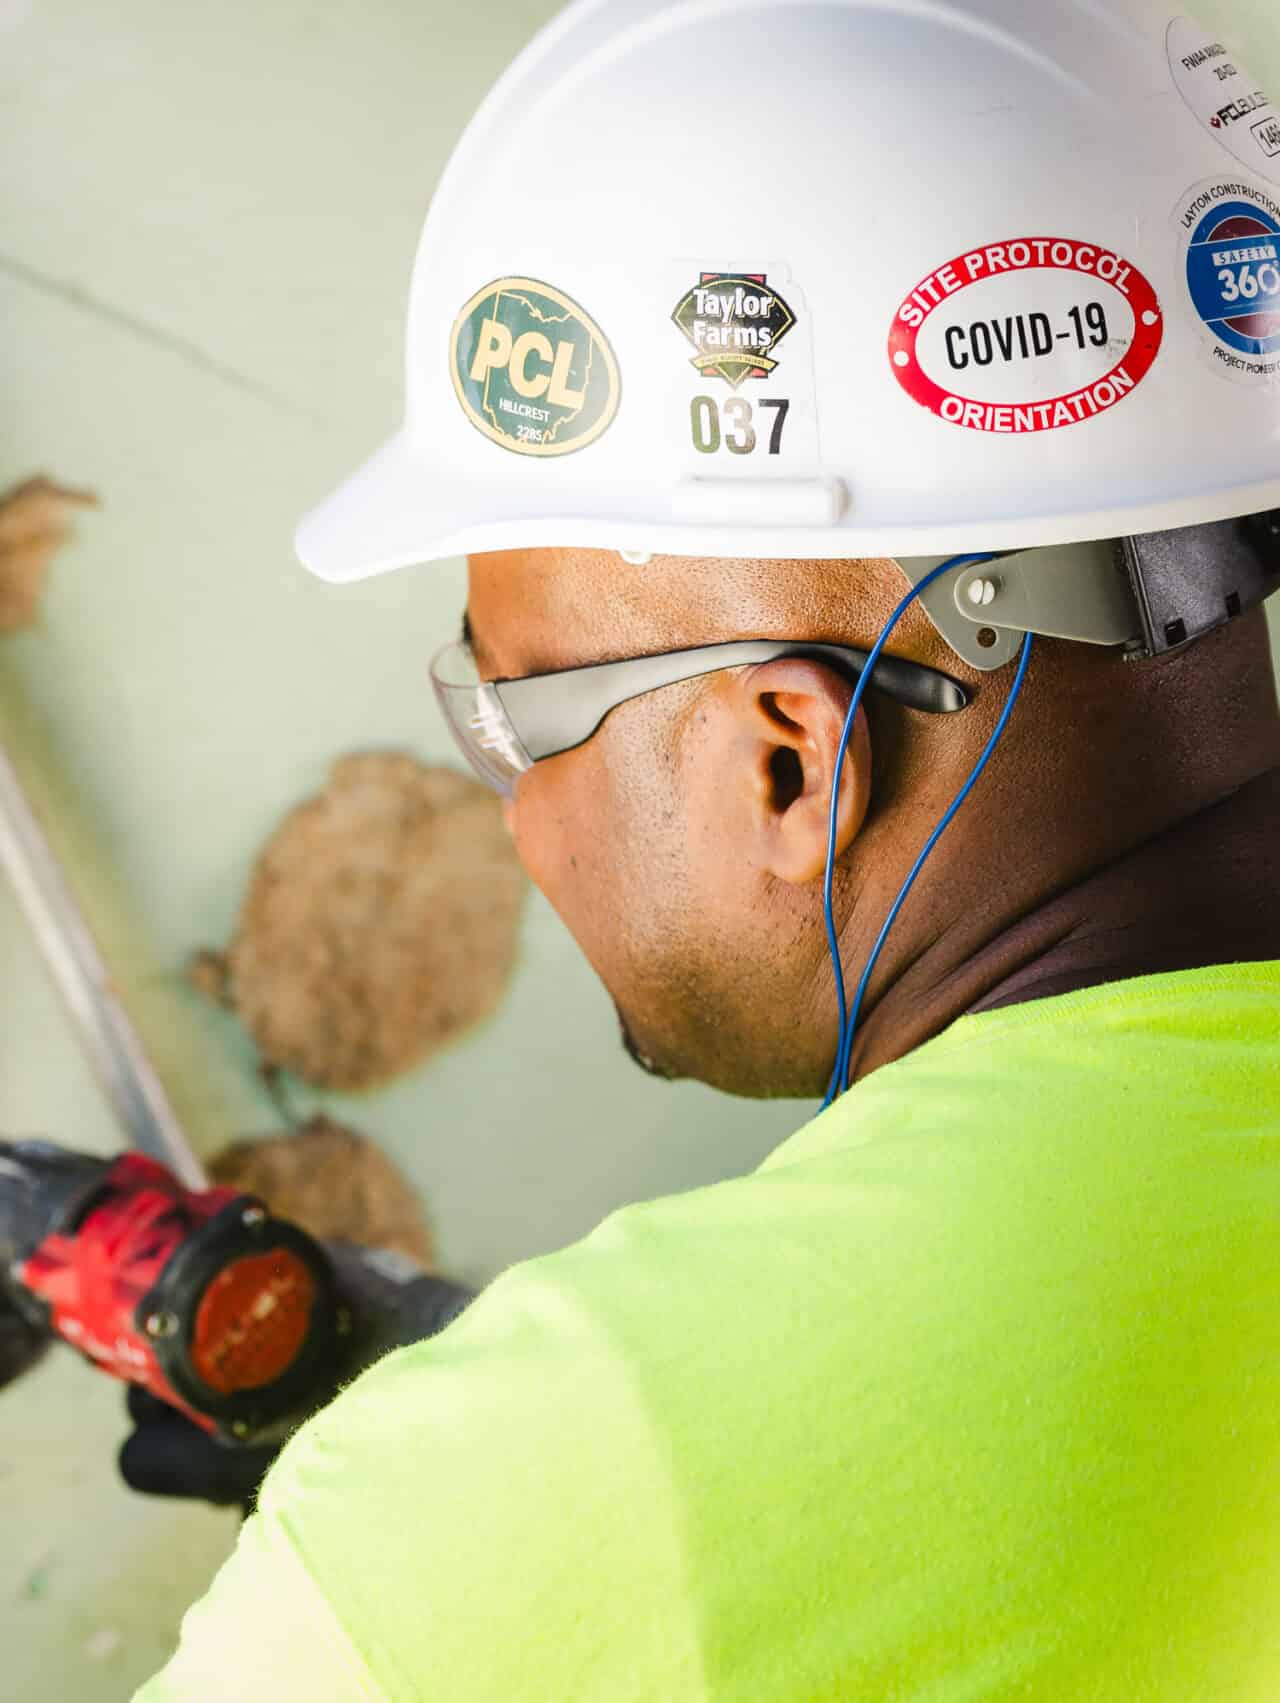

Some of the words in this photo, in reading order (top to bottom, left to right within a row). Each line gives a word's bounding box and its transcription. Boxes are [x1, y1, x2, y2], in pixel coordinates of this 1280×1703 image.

[1180, 191, 1212, 229] LAYTON
[1218, 247, 1270, 264] SAFETY
[899, 264, 963, 328] SITE
[962, 240, 1132, 295] PROTOCOL
[693, 287, 773, 323] Taylor
[693, 320, 772, 348] Farms
[945, 302, 1109, 370] COVID-19
[469, 318, 588, 410] PCL
[1213, 346, 1246, 371] PROJECT
[499, 397, 550, 423] HILLCREST
[940, 366, 1136, 432] ORIENTATION
[689, 395, 790, 455] 037
